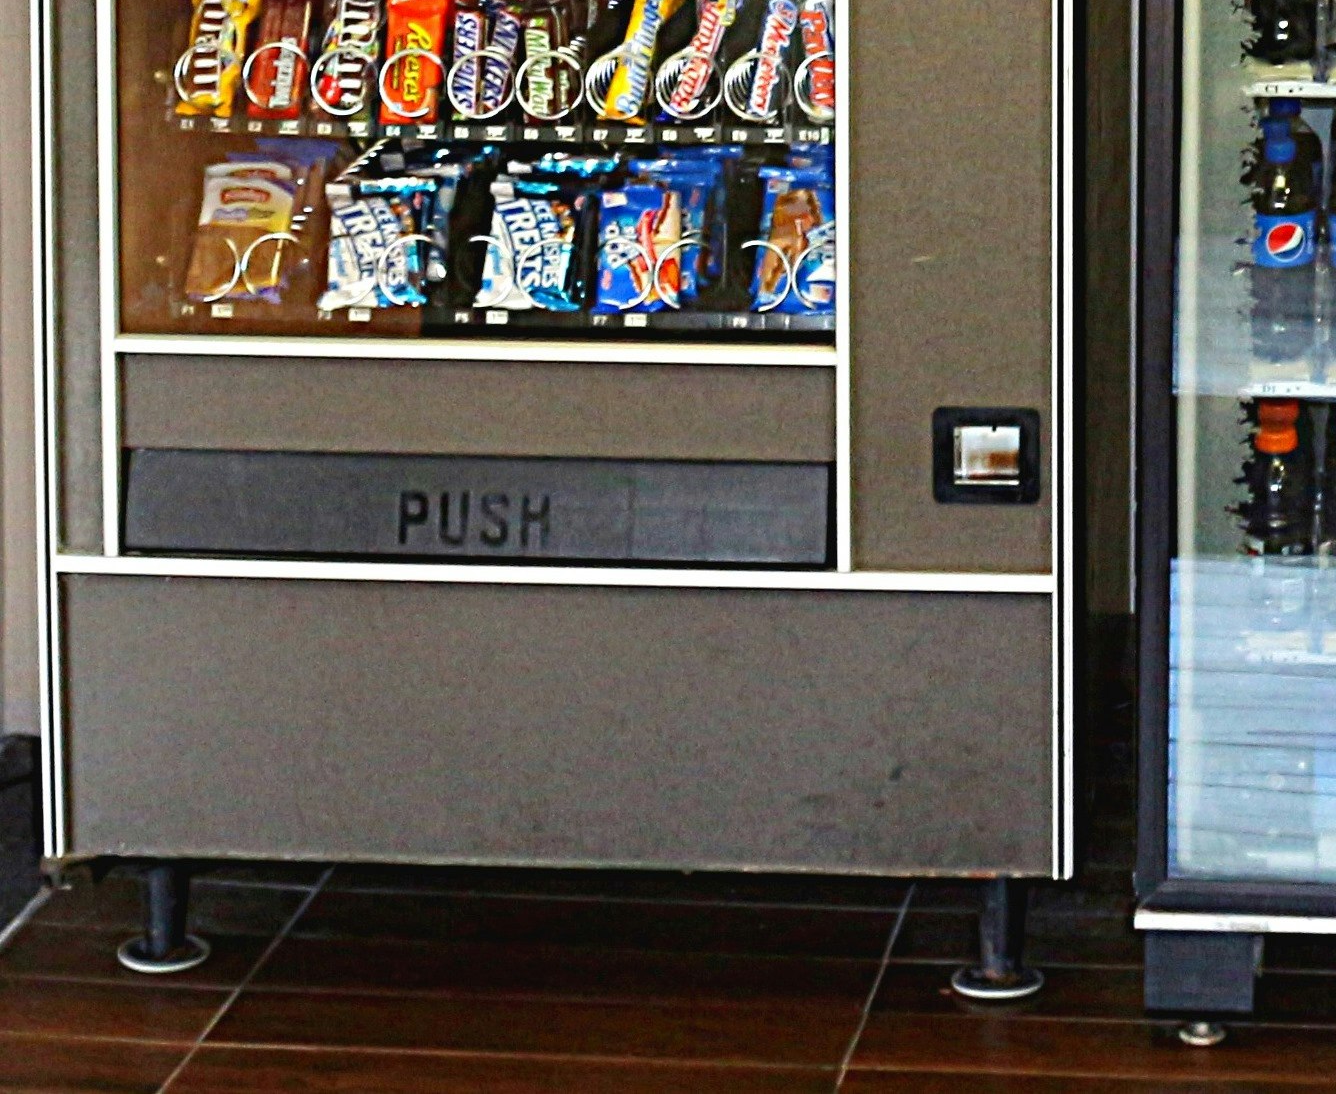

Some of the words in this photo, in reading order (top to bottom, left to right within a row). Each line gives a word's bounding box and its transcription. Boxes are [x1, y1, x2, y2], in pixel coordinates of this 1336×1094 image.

[453, 12, 478, 110] SNICKERS
[496, 199, 542, 288] TREATS
[398, 489, 549, 547] PUSH
